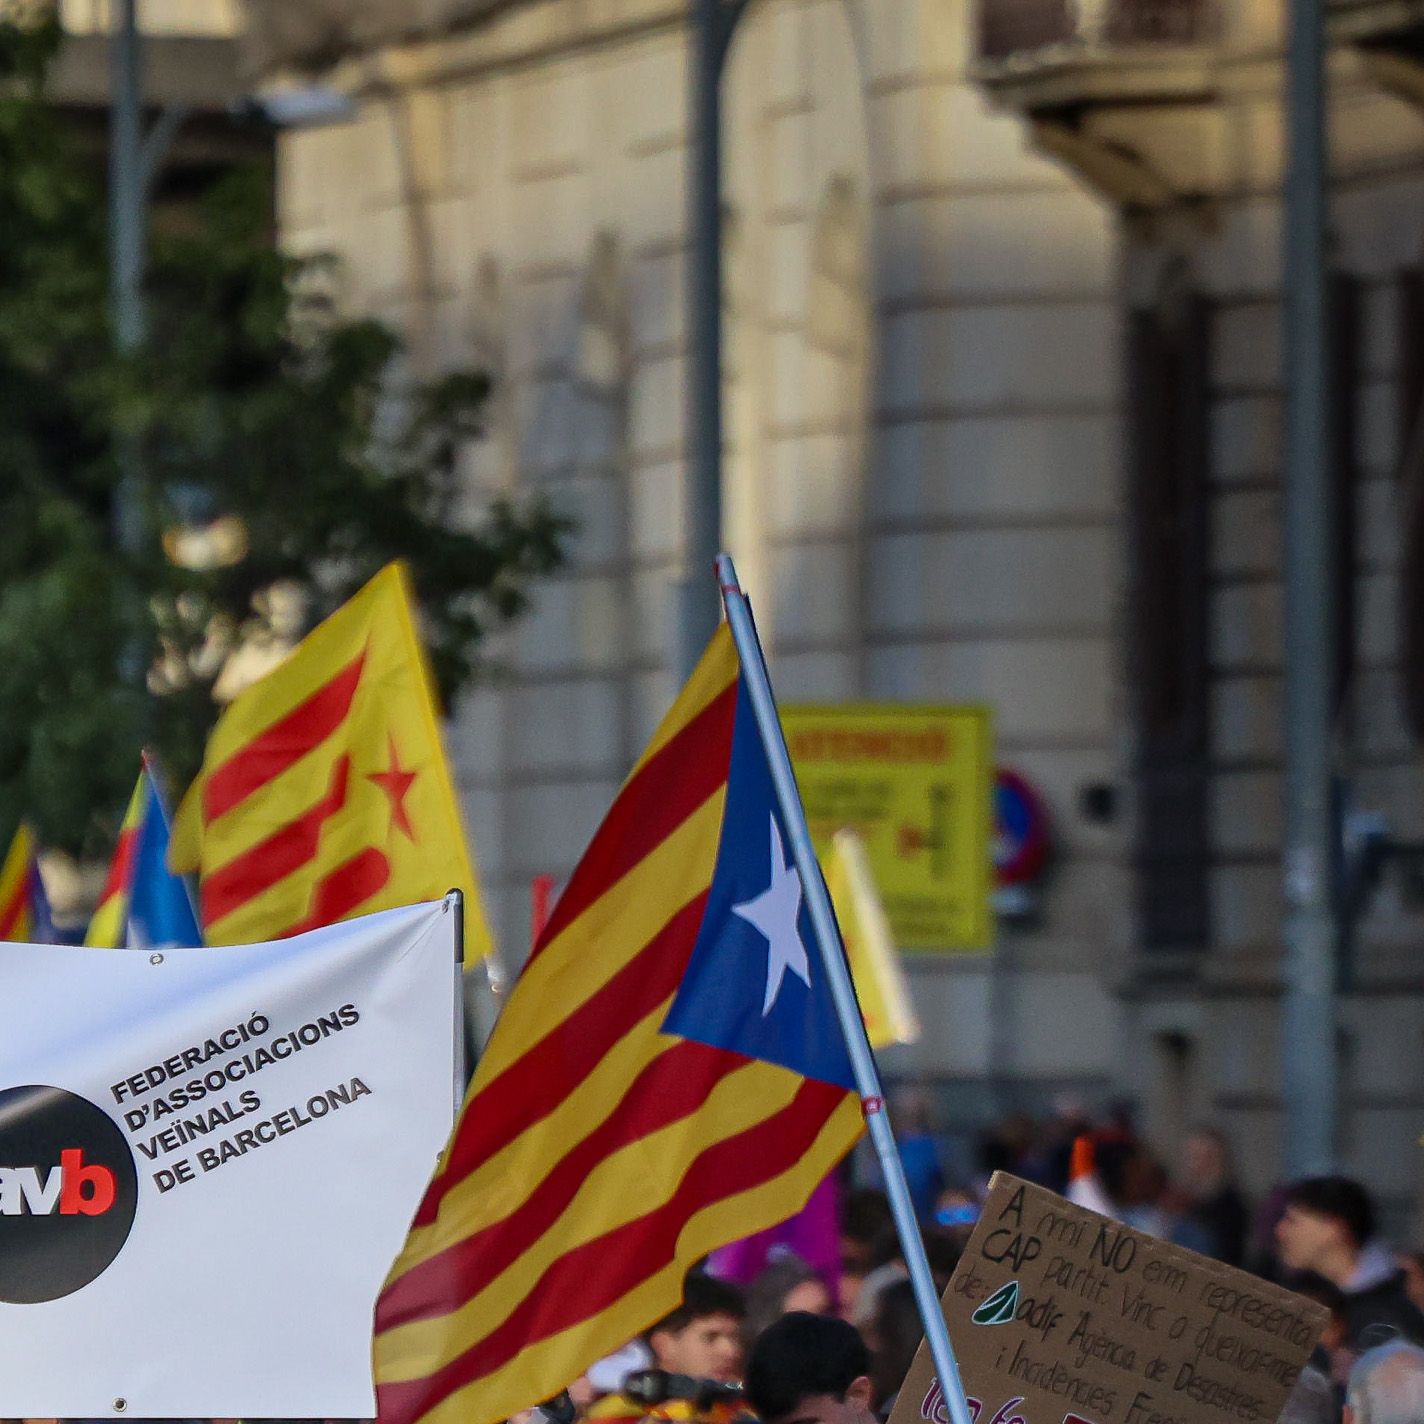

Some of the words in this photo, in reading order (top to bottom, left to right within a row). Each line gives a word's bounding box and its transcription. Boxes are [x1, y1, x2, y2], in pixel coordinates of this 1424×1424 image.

[109, 1010, 271, 1105] FEDERACIÓ
[122, 1002, 361, 1134] D'ASSOCIACIONS
[135, 1089, 262, 1161] VEÏNALS
[151, 1158, 196, 1195] DE
[200, 1076, 373, 1173] BARCELONA
[982, 1228, 1042, 1273] CAP
[999, 1185, 1025, 1227] A
[1036, 1212, 1089, 1247] mi
[1089, 1224, 1137, 1274] NO
[1143, 1261, 1188, 1293] em
[1204, 1282, 1312, 1346] representa
[996, 1347, 1007, 1368] i
[1015, 1297, 1063, 1342] adif
[1144, 1356, 1168, 1382] de
